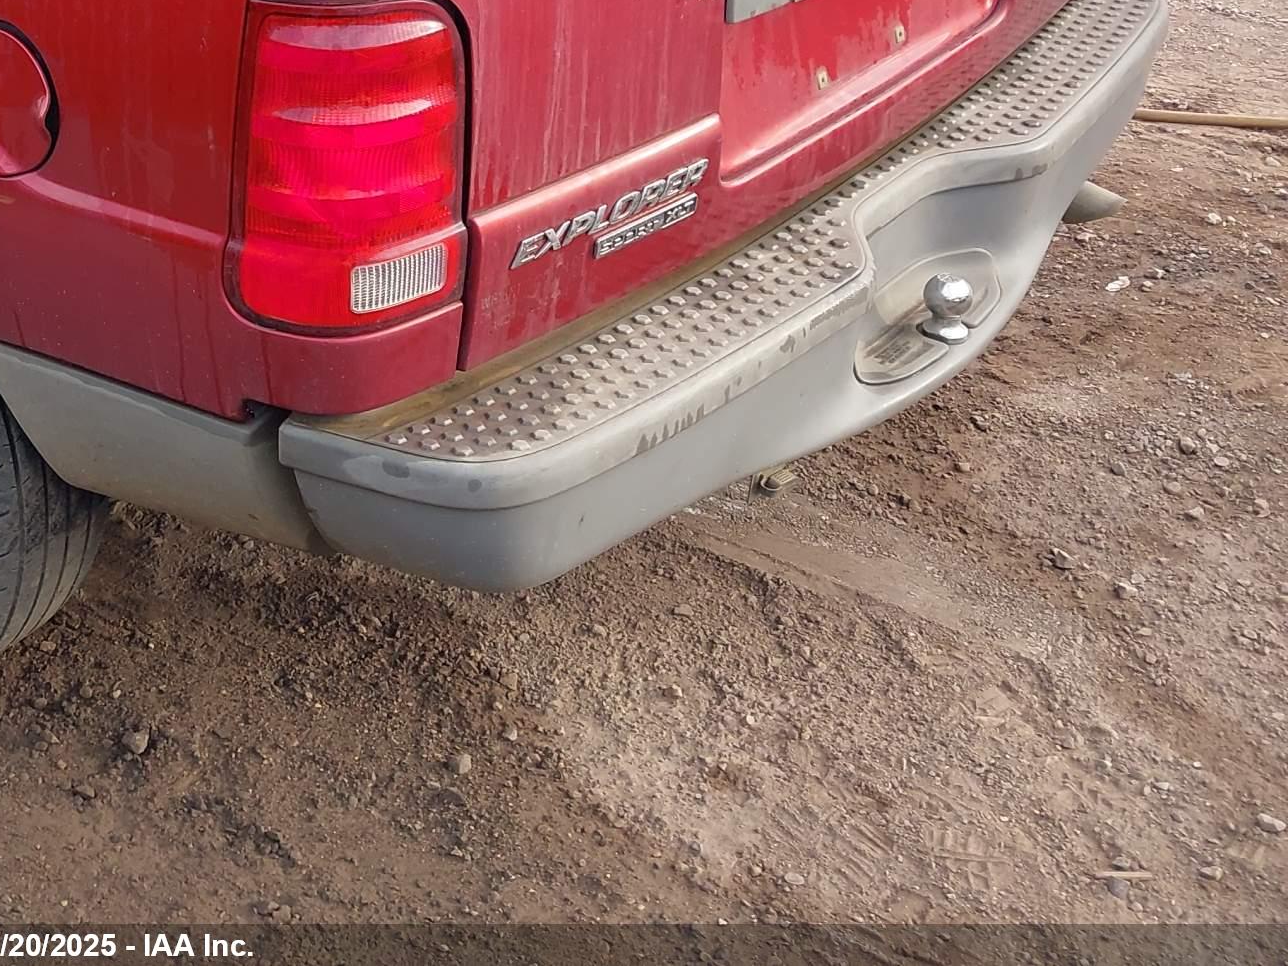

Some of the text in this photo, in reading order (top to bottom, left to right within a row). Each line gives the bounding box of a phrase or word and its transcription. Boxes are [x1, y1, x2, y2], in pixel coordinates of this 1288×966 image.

[509, 158, 709, 270] EXPLORER
[598, 200, 696, 255] SPORT XLT
